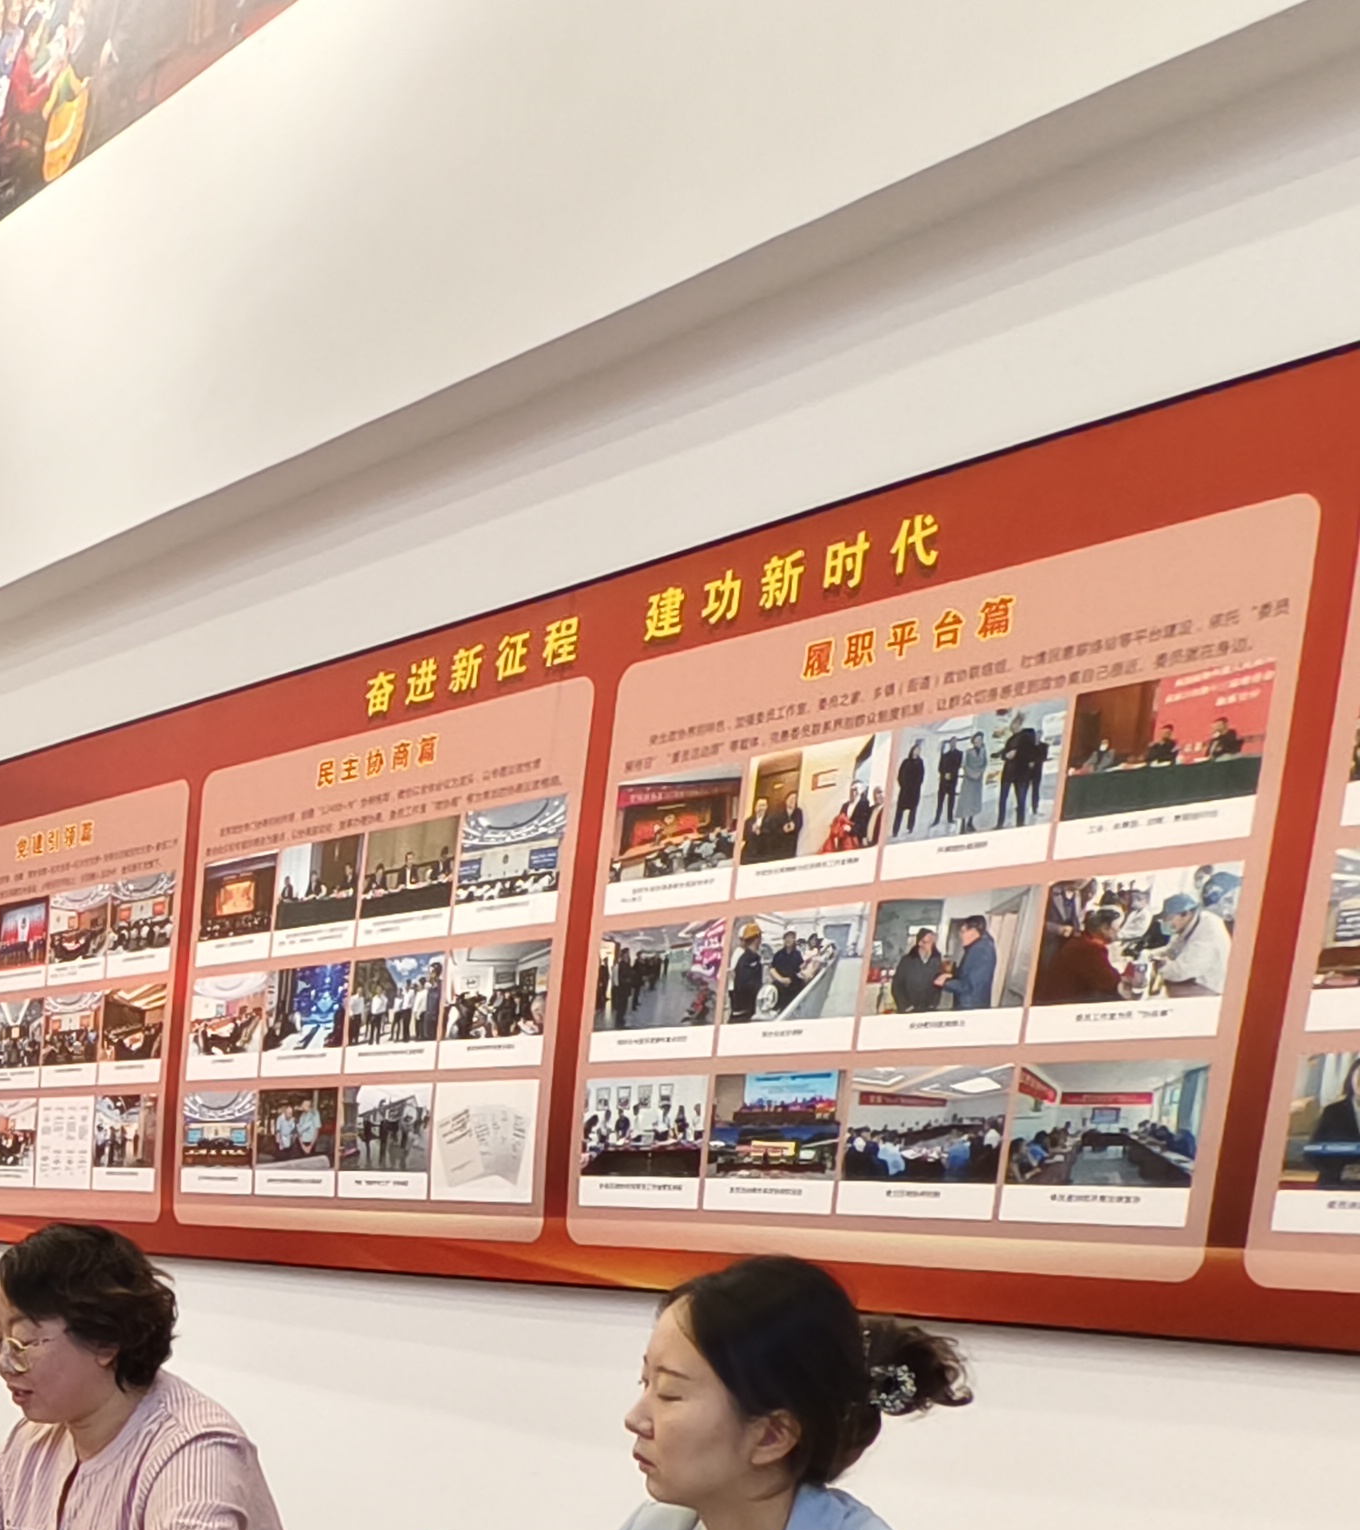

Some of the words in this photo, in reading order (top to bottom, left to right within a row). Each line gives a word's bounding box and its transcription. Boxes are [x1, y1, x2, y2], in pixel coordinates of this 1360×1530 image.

[365, 615, 579, 718] 奋进新征程
[643, 514, 941, 642] 建功新时代
[802, 597, 1015, 678] 履职平台篇
[315, 733, 440, 788] 民主协商篇
[15, 819, 95, 860] 党建引领篇
